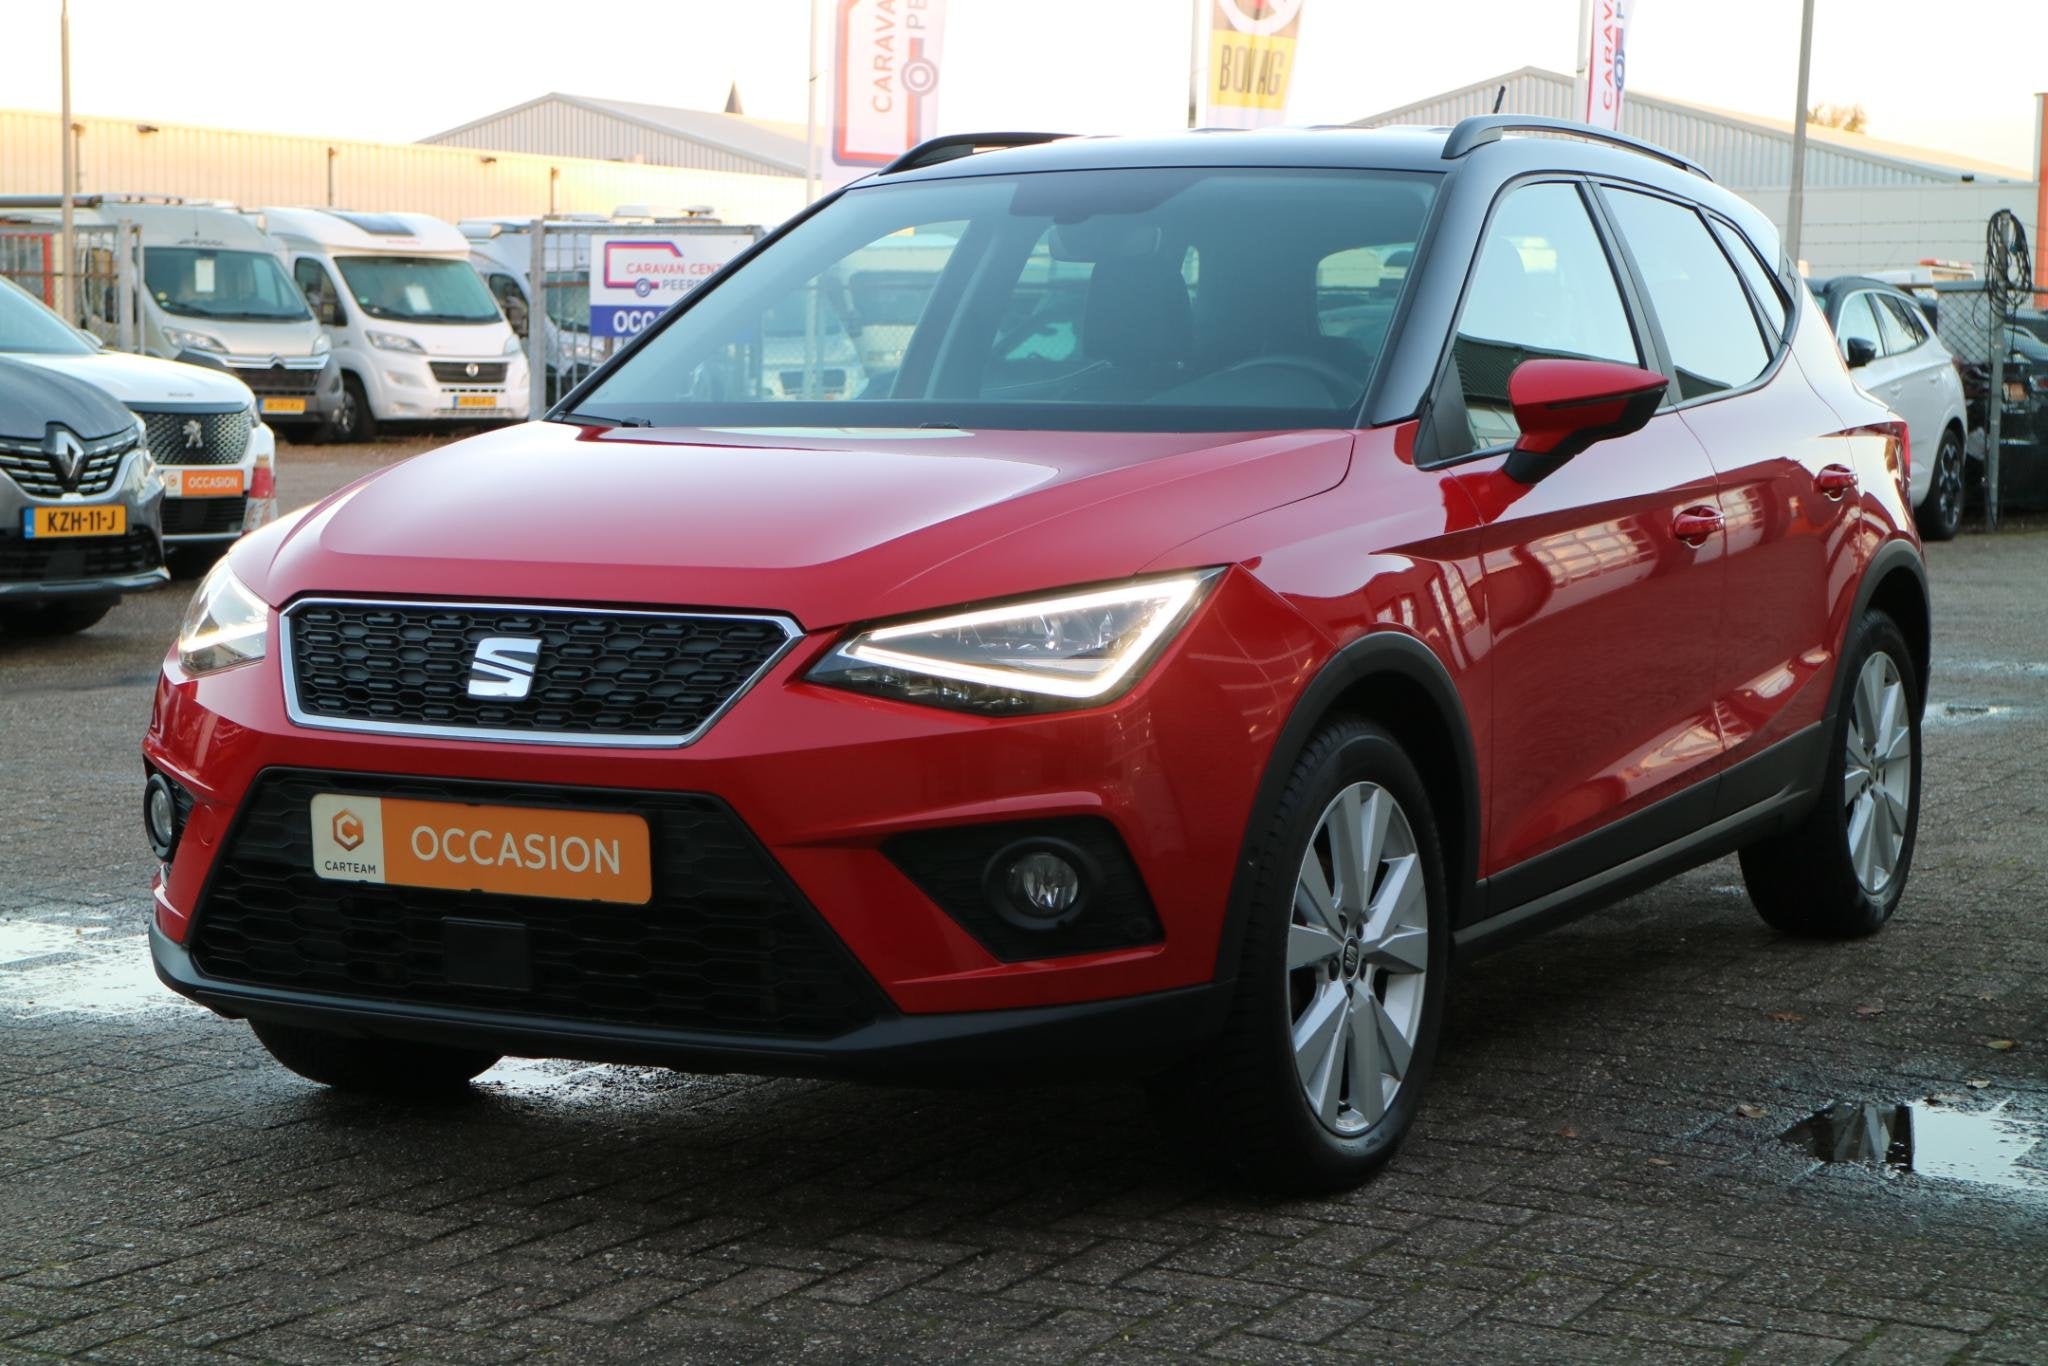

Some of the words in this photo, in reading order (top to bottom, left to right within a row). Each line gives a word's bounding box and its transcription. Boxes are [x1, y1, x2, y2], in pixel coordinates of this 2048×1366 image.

[1603, 0, 1614, 110] CARAV
[626, 263, 685, 275] CARAVAN
[188, 476, 238, 488] OCCASION
[47, 510, 116, 532] KZH-11-J
[410, 825, 621, 876] OCCASION
[324, 860, 377, 875] CARTEAM
